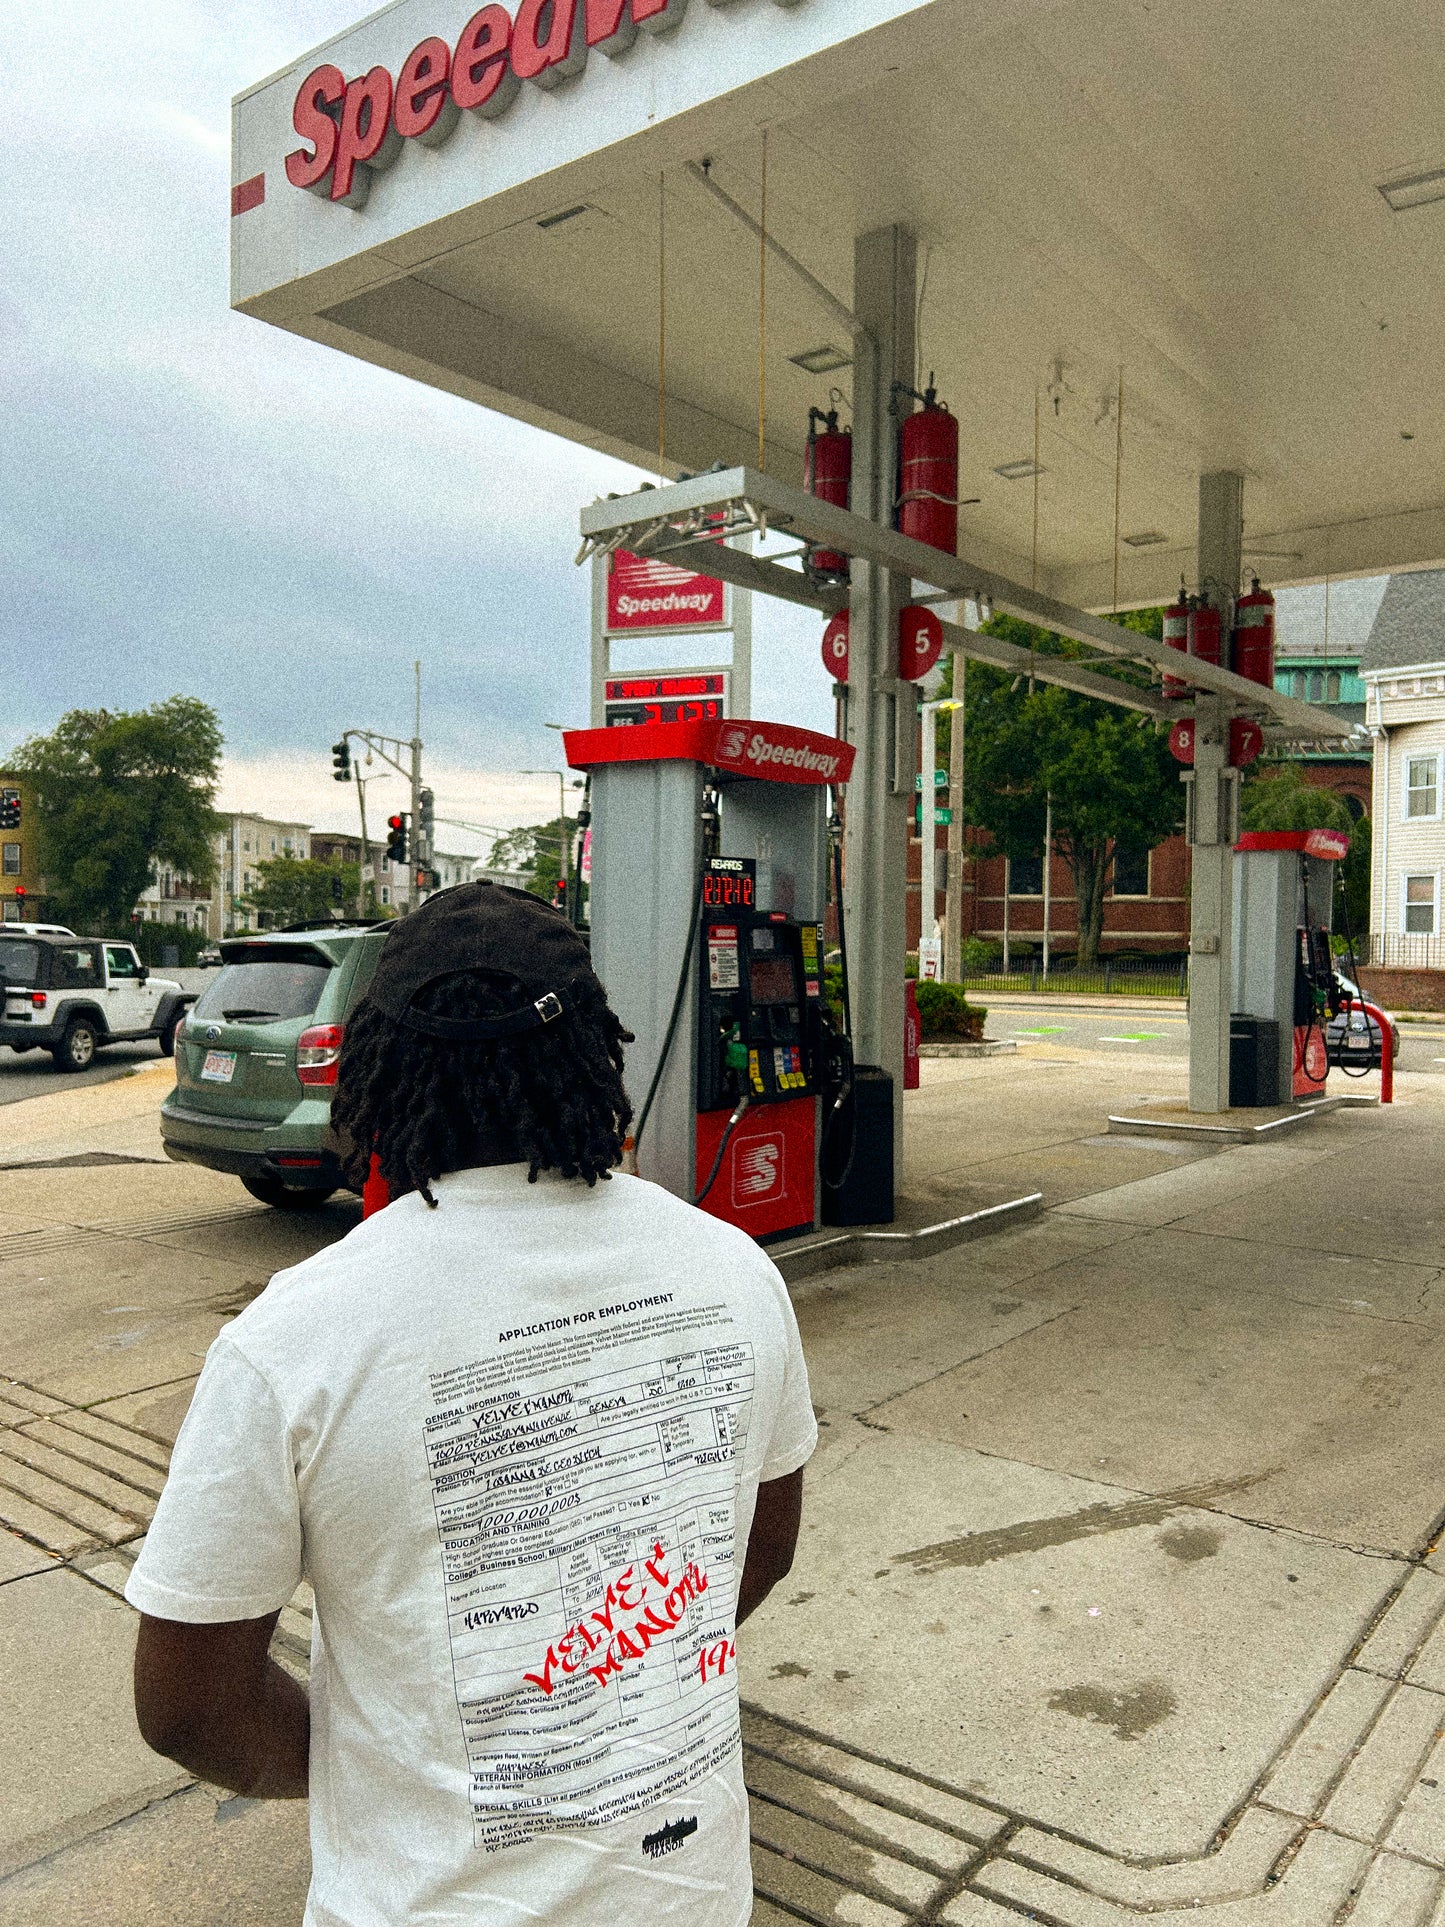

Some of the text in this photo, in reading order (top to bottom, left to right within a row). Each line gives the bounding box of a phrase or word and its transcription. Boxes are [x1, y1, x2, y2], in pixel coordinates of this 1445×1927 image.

[617, 592, 713, 617] Speedway
[833, 632, 846, 658] 6
[915, 629, 930, 655] 5
[1179, 731, 1189, 748] 8
[1241, 731, 1252, 750] 7
[747, 734, 839, 778] Speedway
[711, 859, 743, 870] REWARDS
[817, 924, 823, 940] 5
[498, 1292, 673, 1342] APPLICATION FOR EMPLOYMENT
[464, 1357, 495, 1370] application
[425, 1390, 520, 1424] GENERAL INFORMATION
[430, 1438, 454, 1451] Address
[435, 1468, 475, 1485] POSITION
[444, 1517, 549, 1549] EDUCATION AND TRAINING
[480, 1559, 515, 1572] Business
[517, 1551, 547, 1564] School,
[480, 1582, 506, 1592] Location
[473, 1772, 510, 1781] VETERAN
[513, 1760, 571, 1780] INFORMATION
[473, 1803, 509, 1813] SPECIAL
[511, 1795, 542, 1810] SKILLS
[650, 1838, 683, 1859] MANOR
